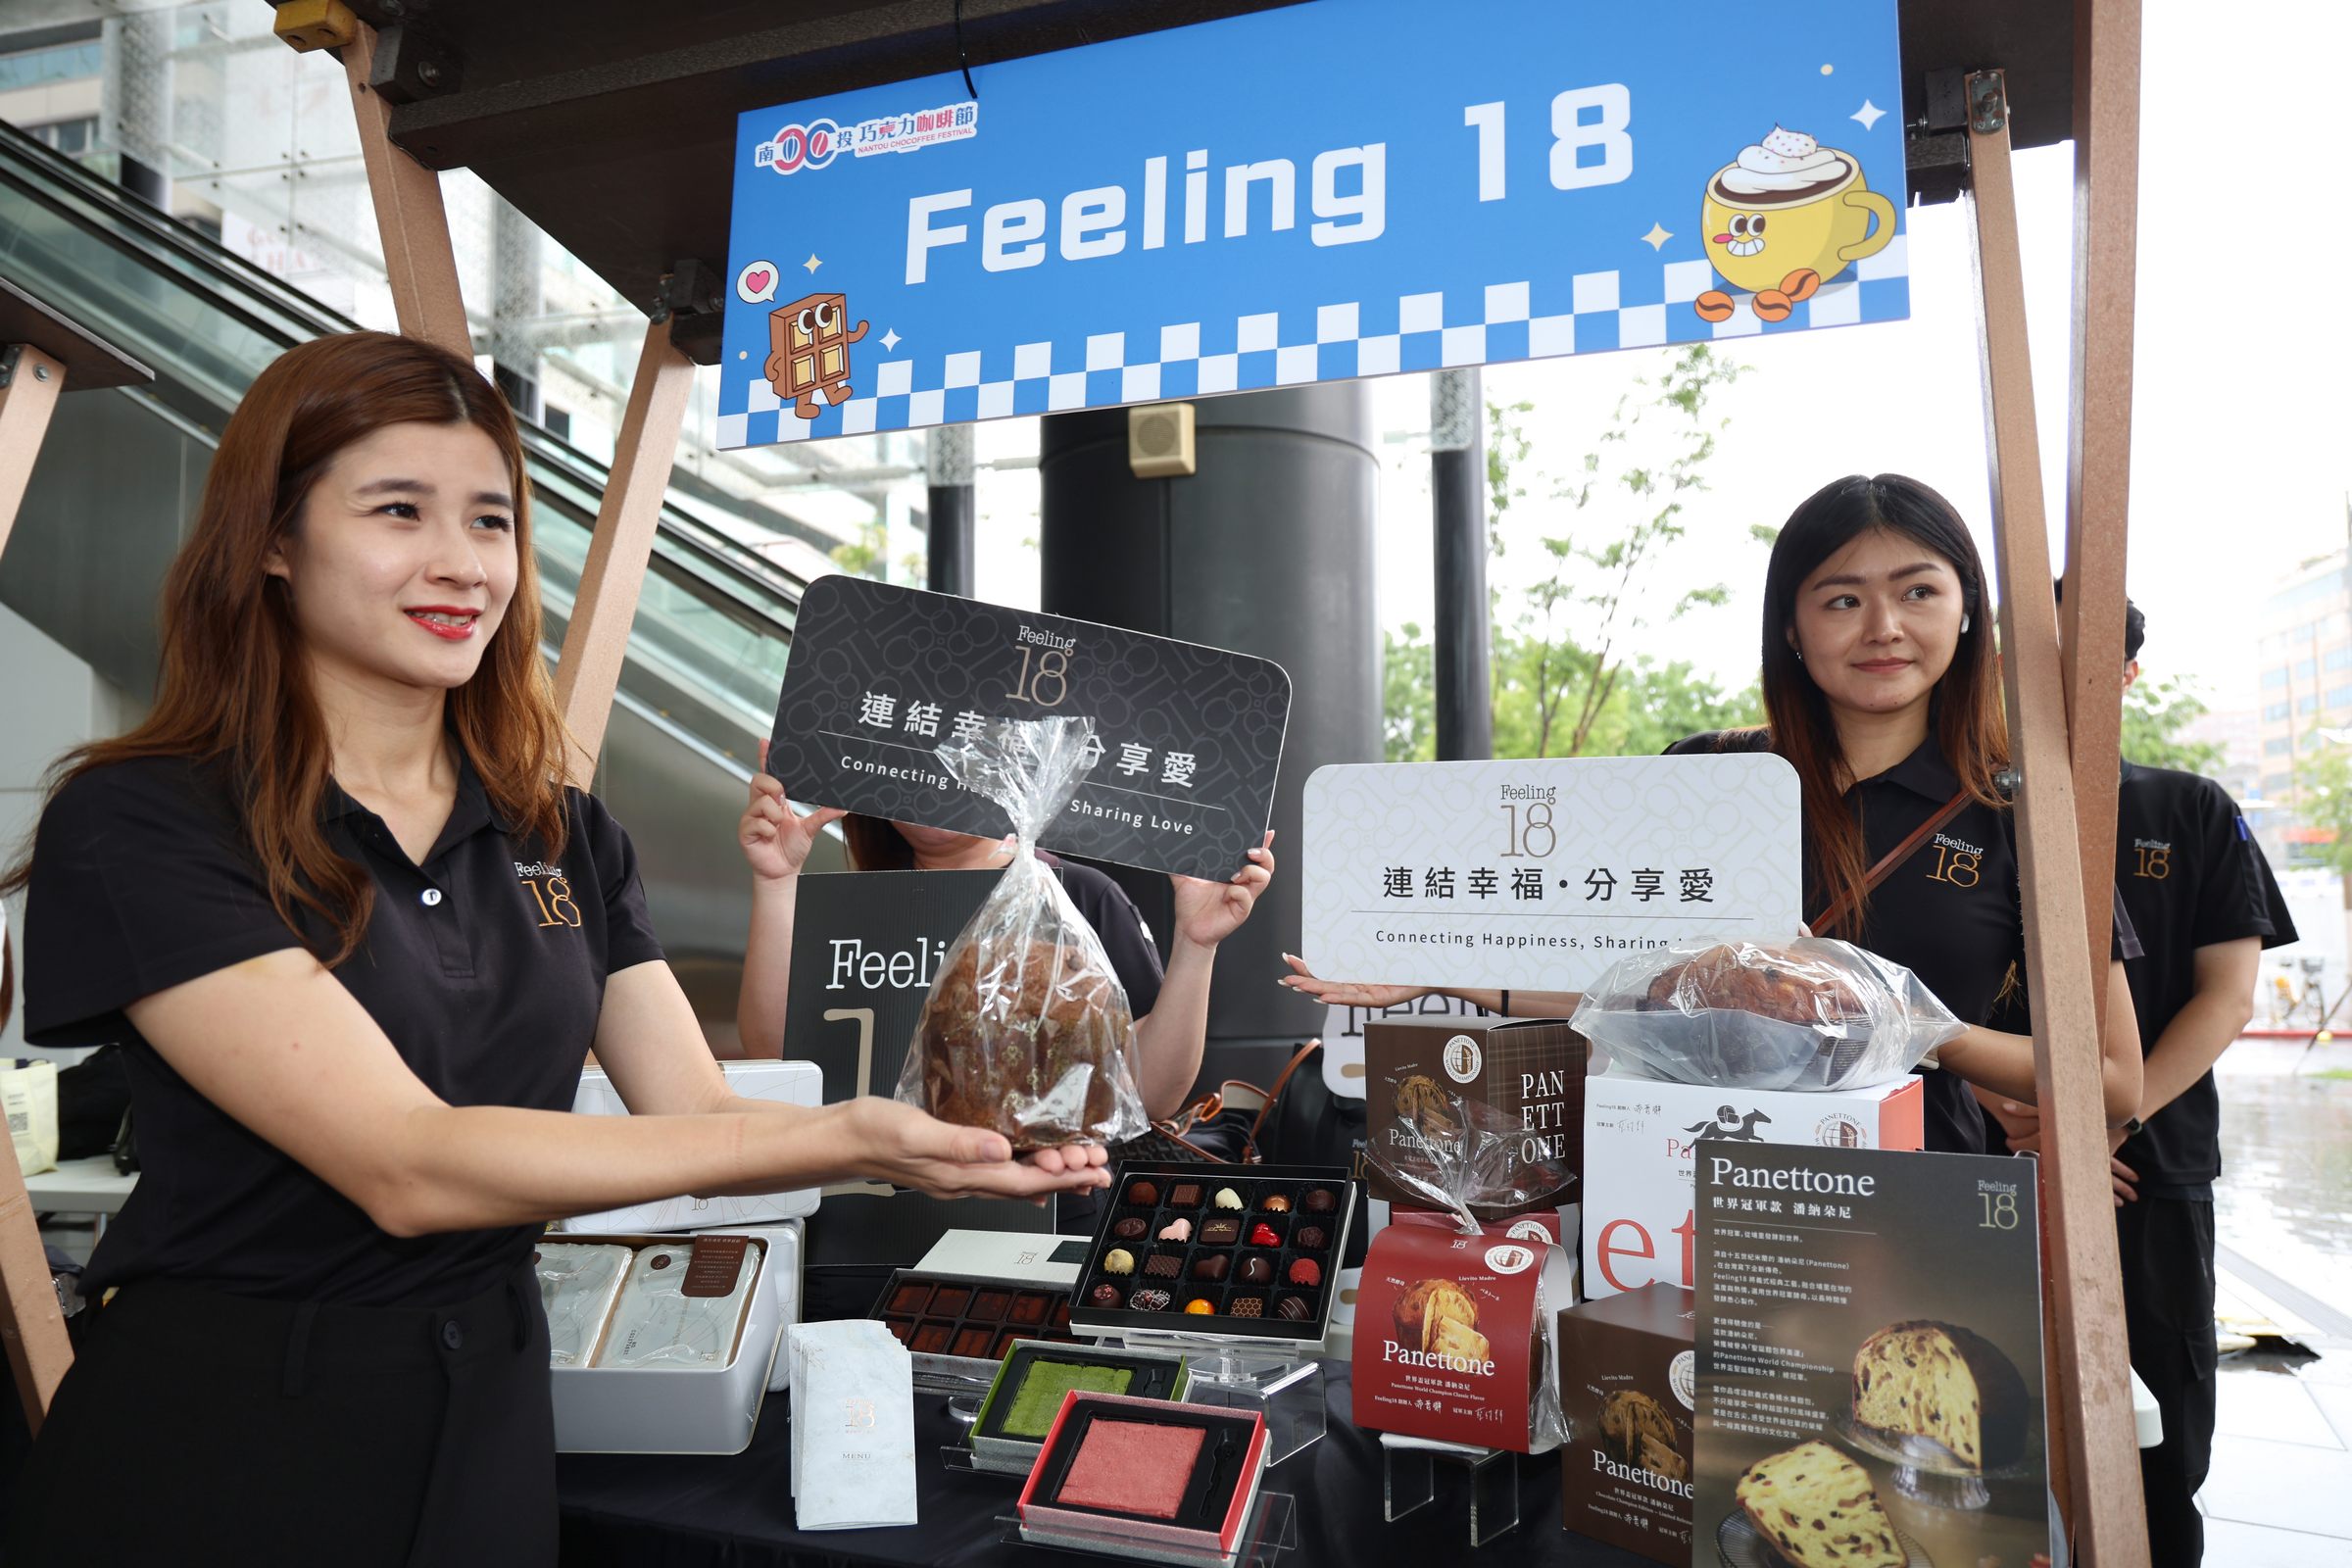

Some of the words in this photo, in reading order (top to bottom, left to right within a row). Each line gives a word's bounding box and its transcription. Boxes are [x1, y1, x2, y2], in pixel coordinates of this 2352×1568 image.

[858, 141, 889, 155] NANTOU
[890, 133, 936, 149] CHOCOFFEE
[938, 127, 973, 140] FESTIVAL
[906, 142, 1386, 285] Feeling
[1464, 83, 1633, 203] 18
[1017, 625, 1075, 651] Feeling
[840, 756, 949, 791] Connecting
[1070, 799, 1144, 830] Sharing
[1151, 808, 1195, 835] Love
[1500, 784, 1556, 801] Feeling
[1935, 833, 1984, 855] Feeling
[2134, 838, 2171, 851] Feeling
[514, 861, 562, 877] Feeling
[1376, 929, 1474, 948] Connecting
[1483, 932, 1585, 951] Happiness,
[1521, 1070, 1565, 1100] PAN
[1521, 1102, 1565, 1132] ETT
[1820, 1112, 1861, 1128] PANETTONE
[1521, 1133, 1566, 1164] ONE
[1710, 1157, 1875, 1197] Panettone
[1978, 1179, 2017, 1193] Feeling
[1712, 1197, 1783, 1214] 世界冠軍款
[1793, 1202, 1852, 1219] 潘納朵尼
[1511, 1223, 1546, 1236] PANETTONE
[1713, 1273, 1747, 1283] Feeling18
[1382, 1340, 1495, 1376] Panettone
[1757, 1357, 1780, 1366] World
[1781, 1360, 1835, 1374] Championship
[1428, 1388, 1453, 1397] Champion
[1592, 1449, 1693, 1499] Panettone
